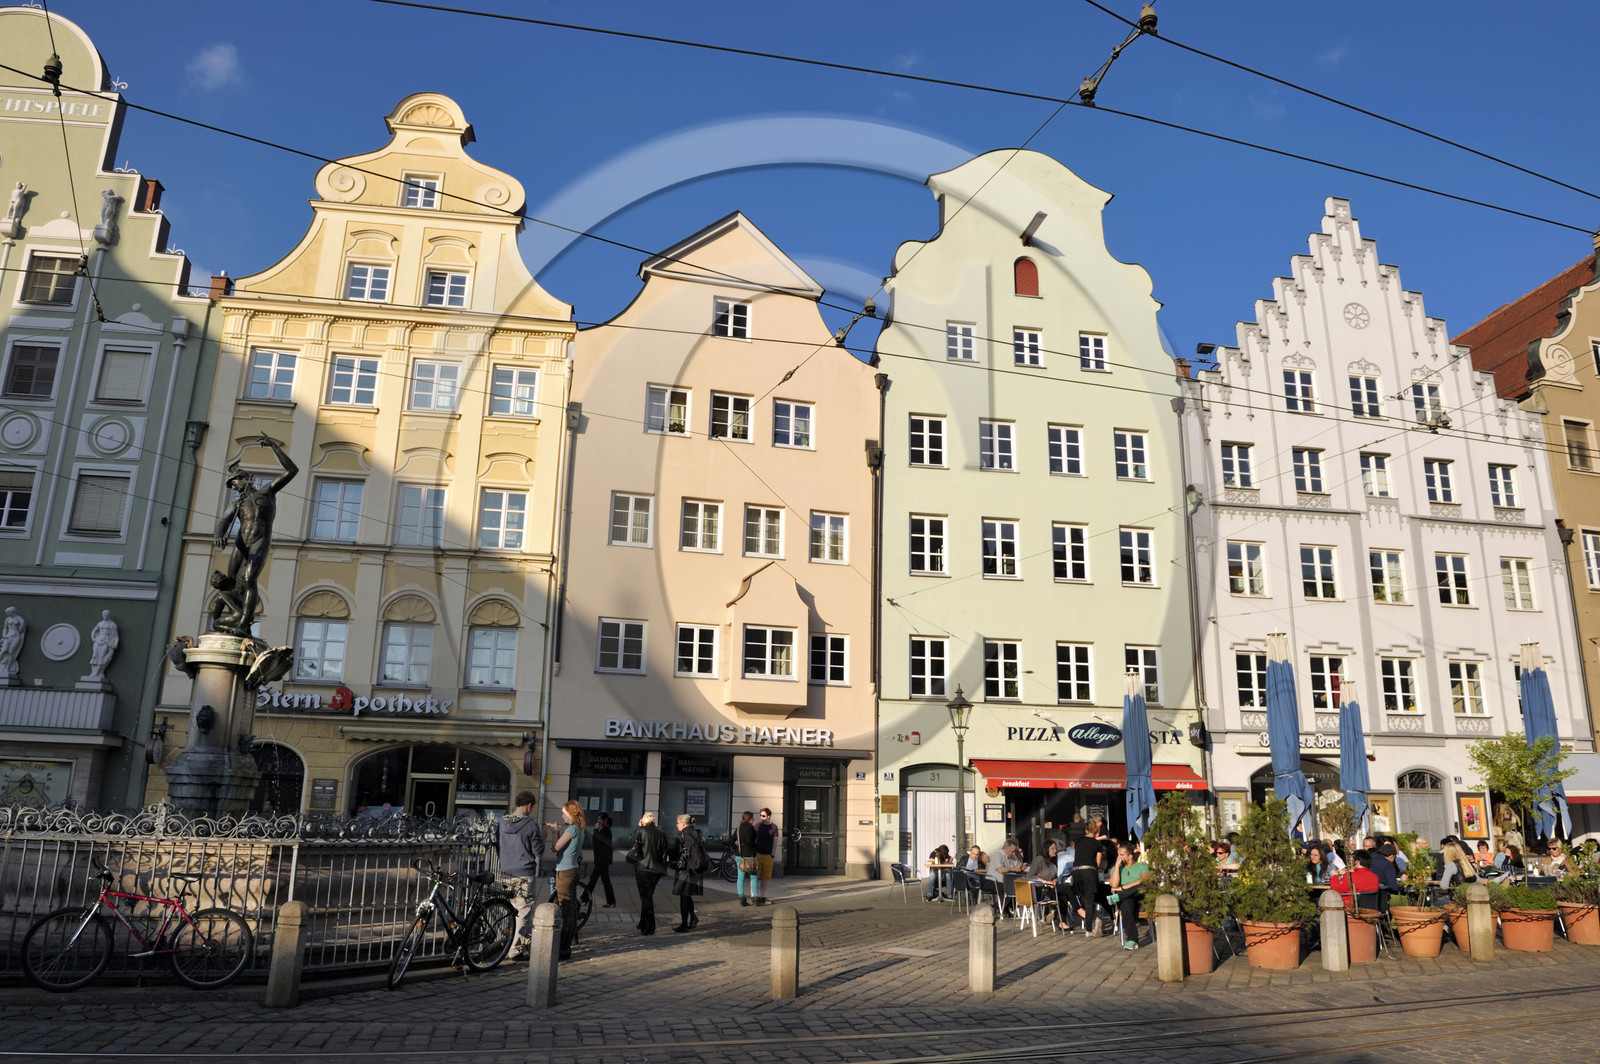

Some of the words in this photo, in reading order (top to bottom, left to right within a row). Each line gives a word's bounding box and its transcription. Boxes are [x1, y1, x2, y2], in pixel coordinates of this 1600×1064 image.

[256, 684, 321, 710] Stern
[328, 686, 454, 717] Apotheke
[605, 717, 736, 742] BANKHAUS
[740, 724, 833, 747] HAFNER
[1007, 726, 1061, 742] PIZZA
[1190, 727, 1200, 739] sky
[1149, 730, 1181, 745] STA
[589, 755, 629, 765] BANKHAUS
[678, 759, 716, 768] BANKHAUS
[594, 763, 623, 771] HAFNER
[682, 766, 711, 774] HAFNER
[800, 770, 826, 778] HAFNER
[930, 772, 941, 782] 31
[1002, 780, 1030, 788] breakfast
